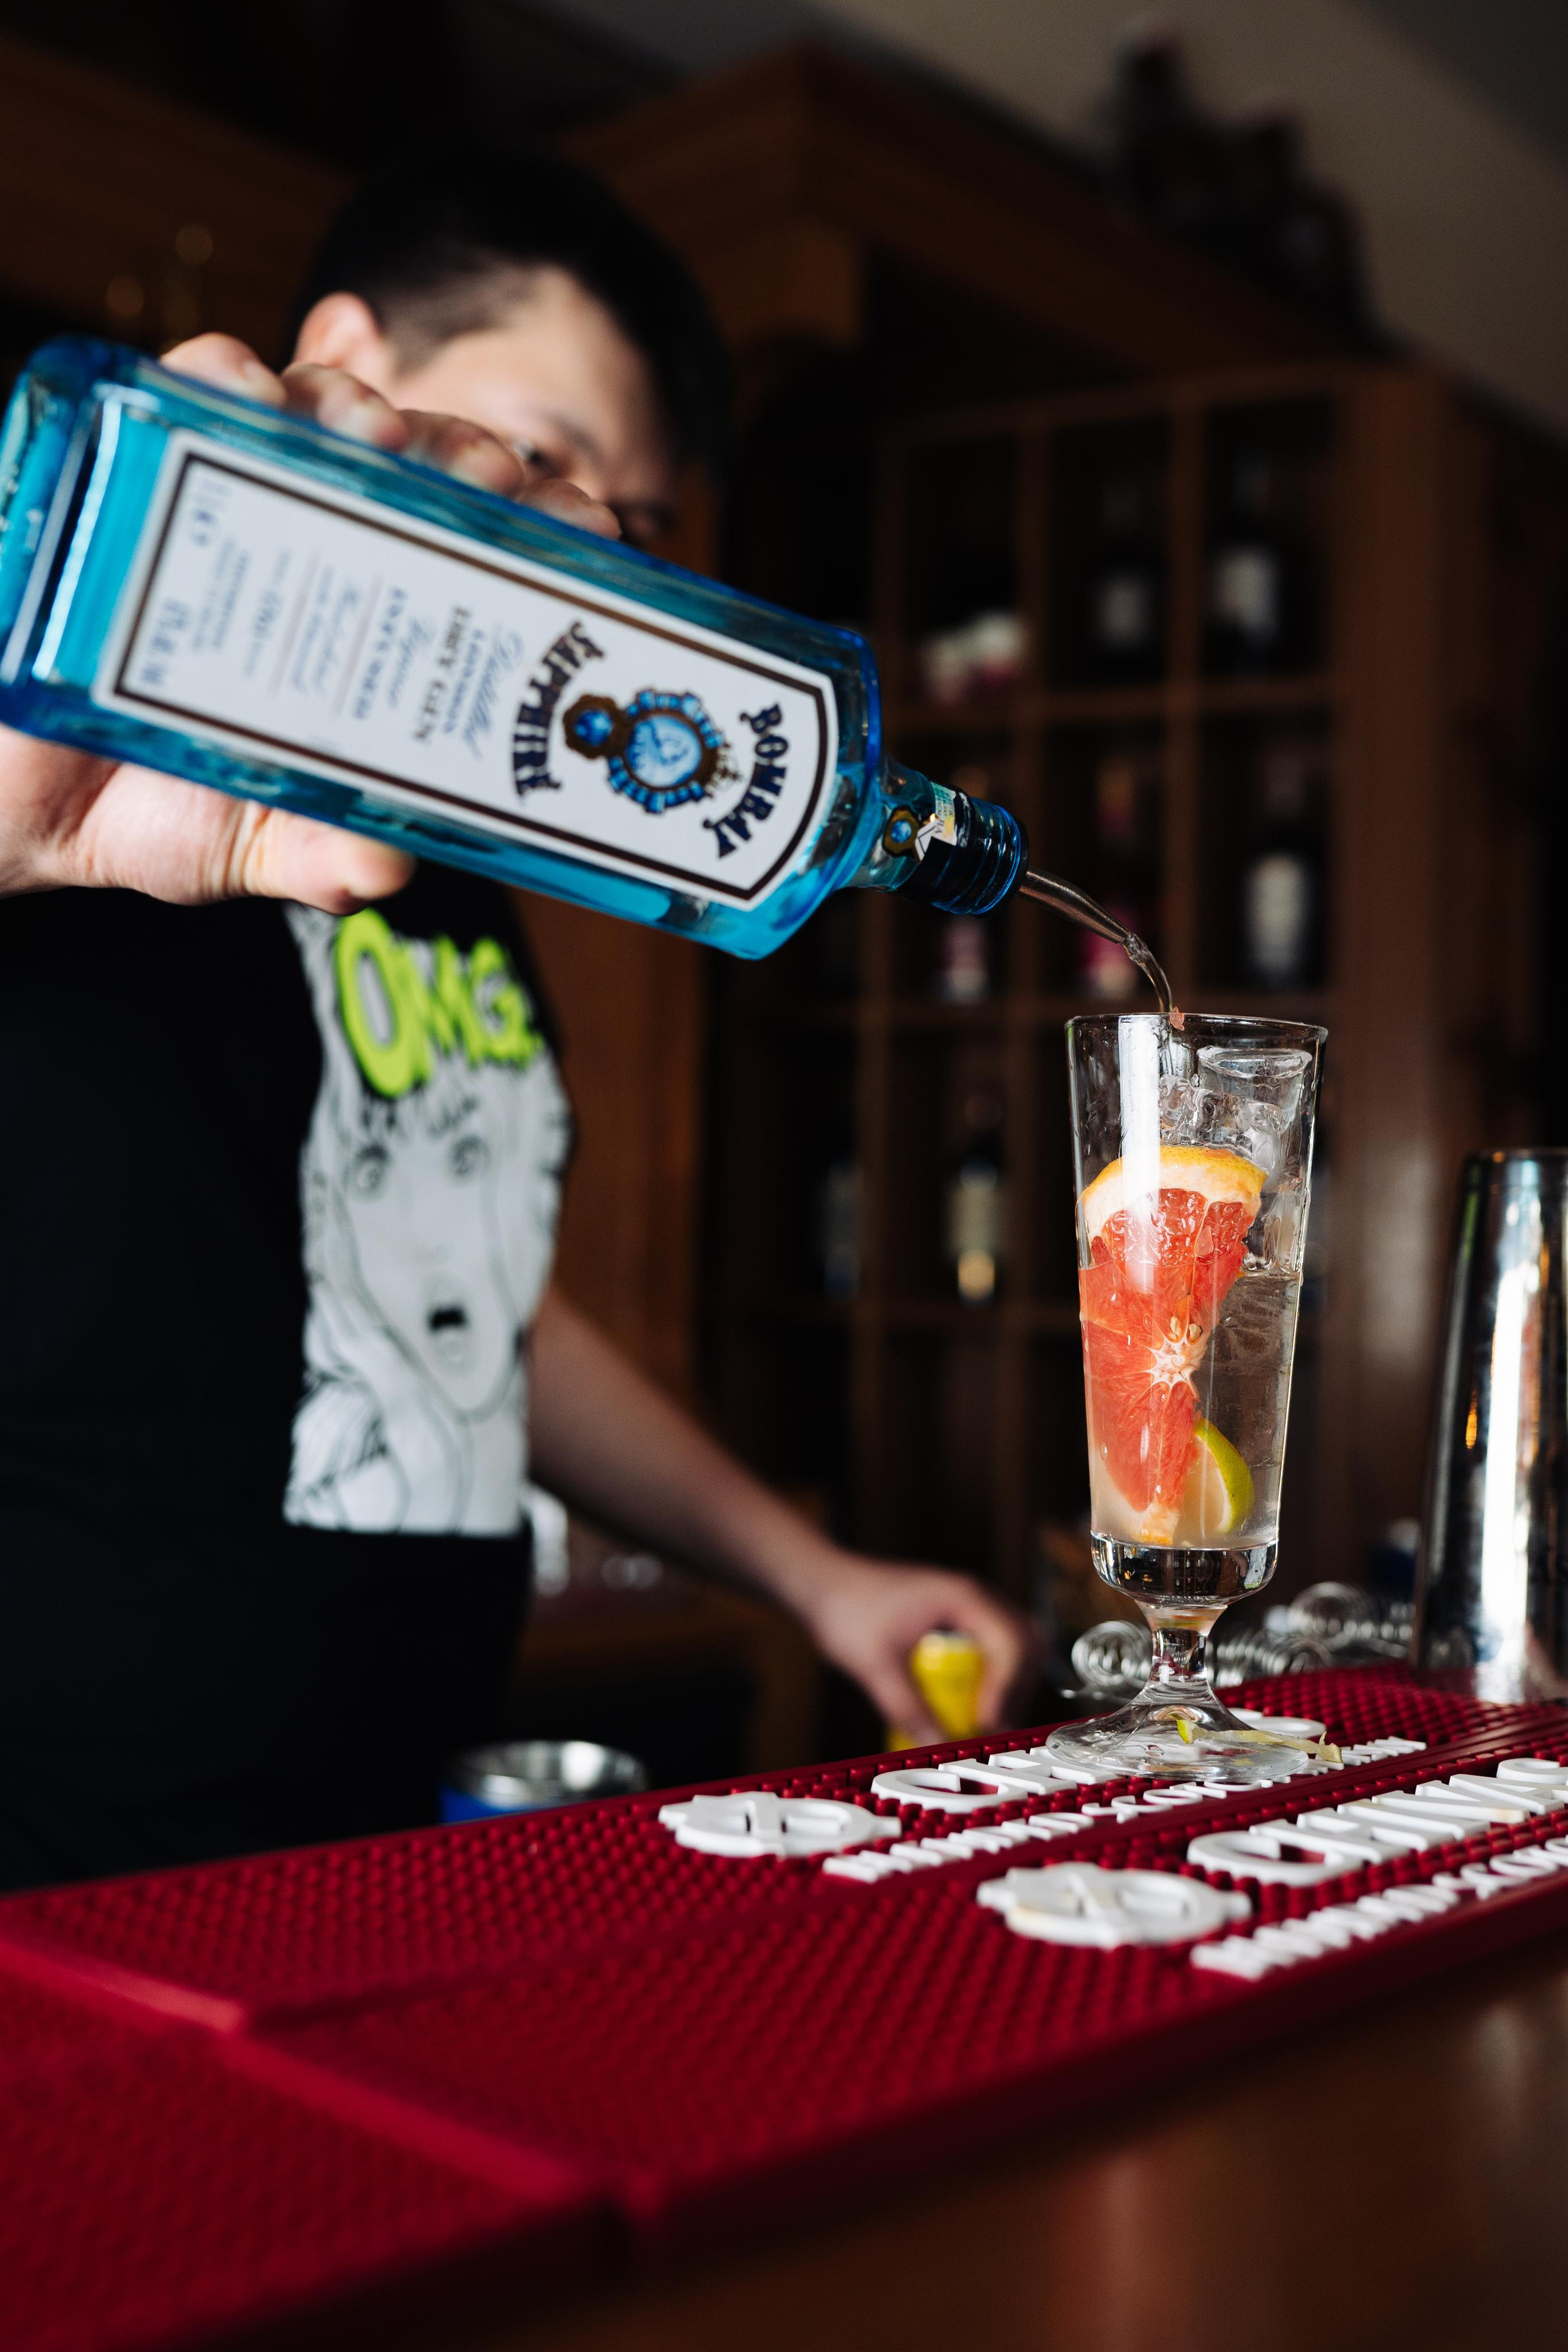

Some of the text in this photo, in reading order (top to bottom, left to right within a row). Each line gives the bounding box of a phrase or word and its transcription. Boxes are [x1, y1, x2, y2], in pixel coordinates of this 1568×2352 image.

[413, 605, 470, 743] DRY GIN
[511, 621, 604, 802] SAPPHIRE
[703, 704, 788, 858] BOMBAY
[334, 907, 545, 1099] OMG
